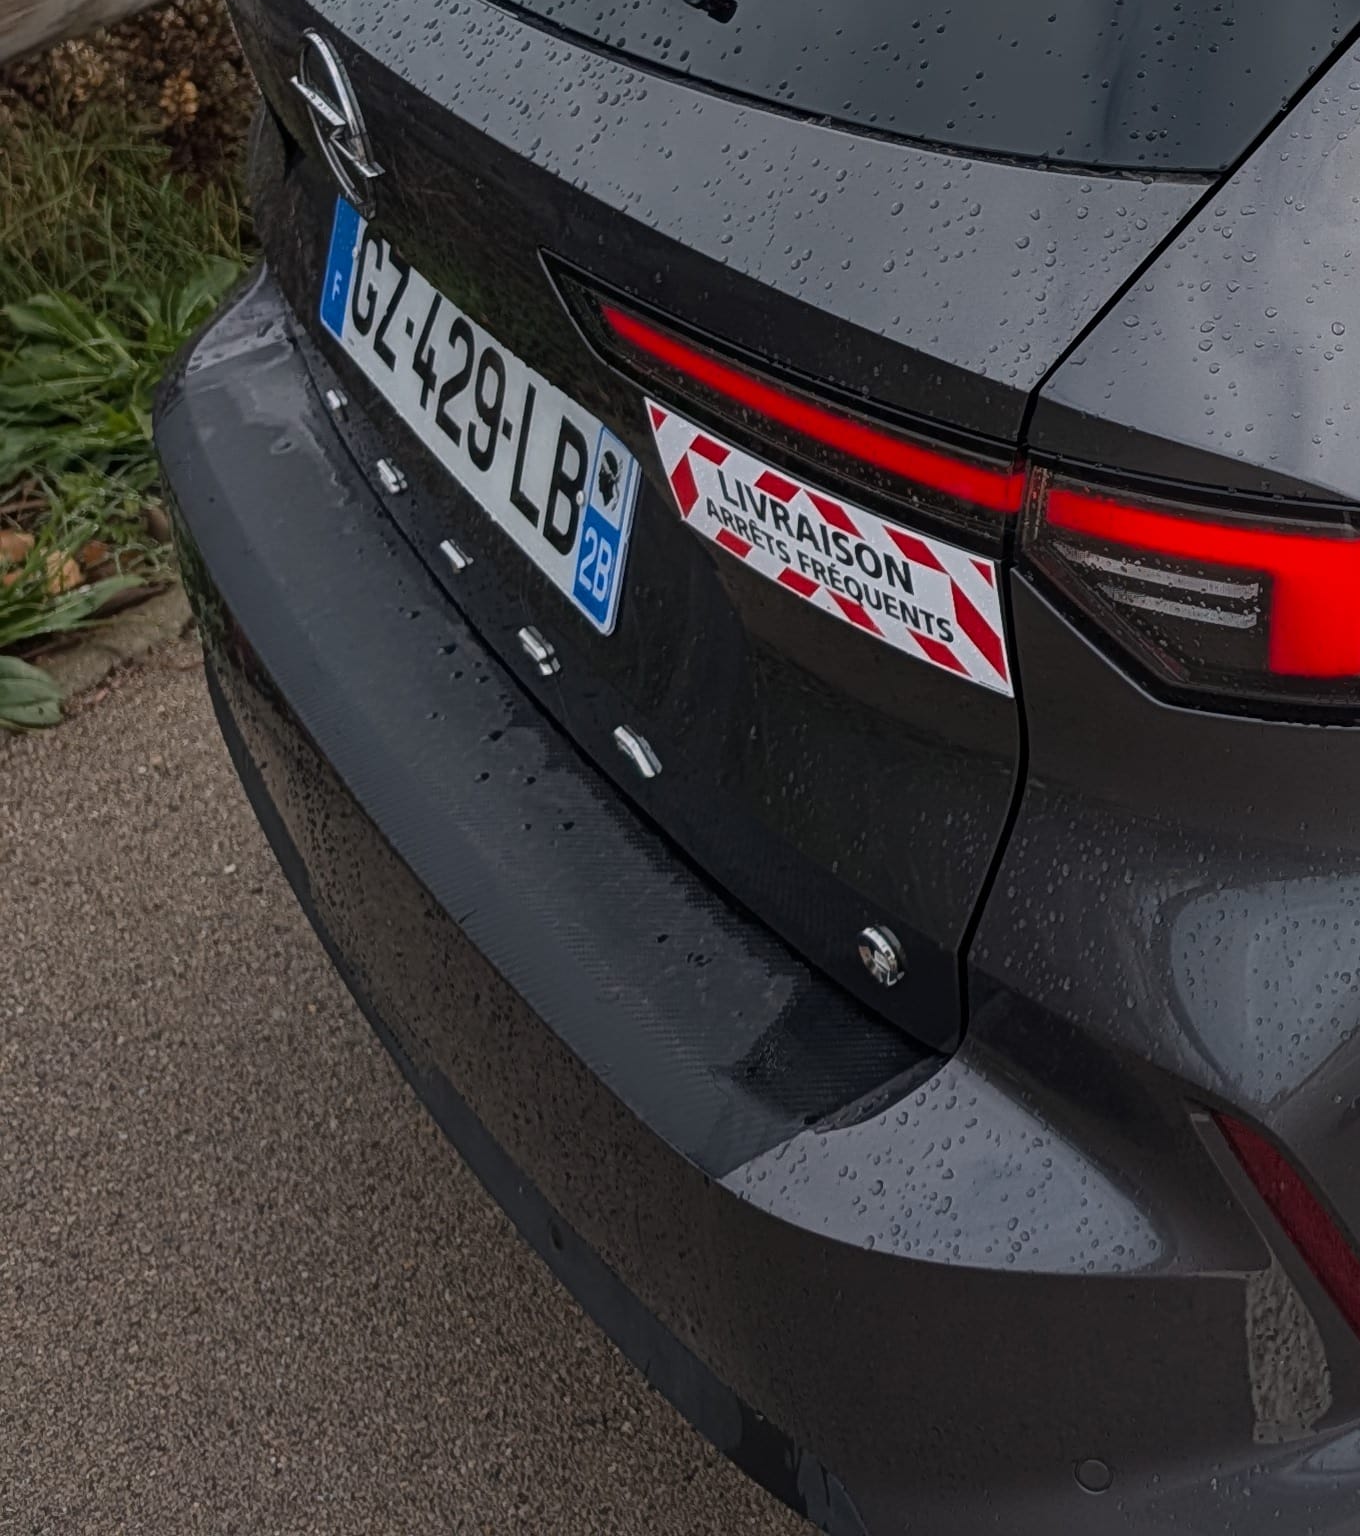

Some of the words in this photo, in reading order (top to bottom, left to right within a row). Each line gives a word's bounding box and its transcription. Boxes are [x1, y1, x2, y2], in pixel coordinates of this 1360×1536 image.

[331, 269, 344, 301] F
[351, 229, 589, 556] GZ-429-LB
[578, 526, 613, 602] 2B
[706, 496, 792, 565] ARRÊTS
[796, 549, 955, 644] FRÉQUENTS
[717, 468, 915, 596] LIVRAISON
